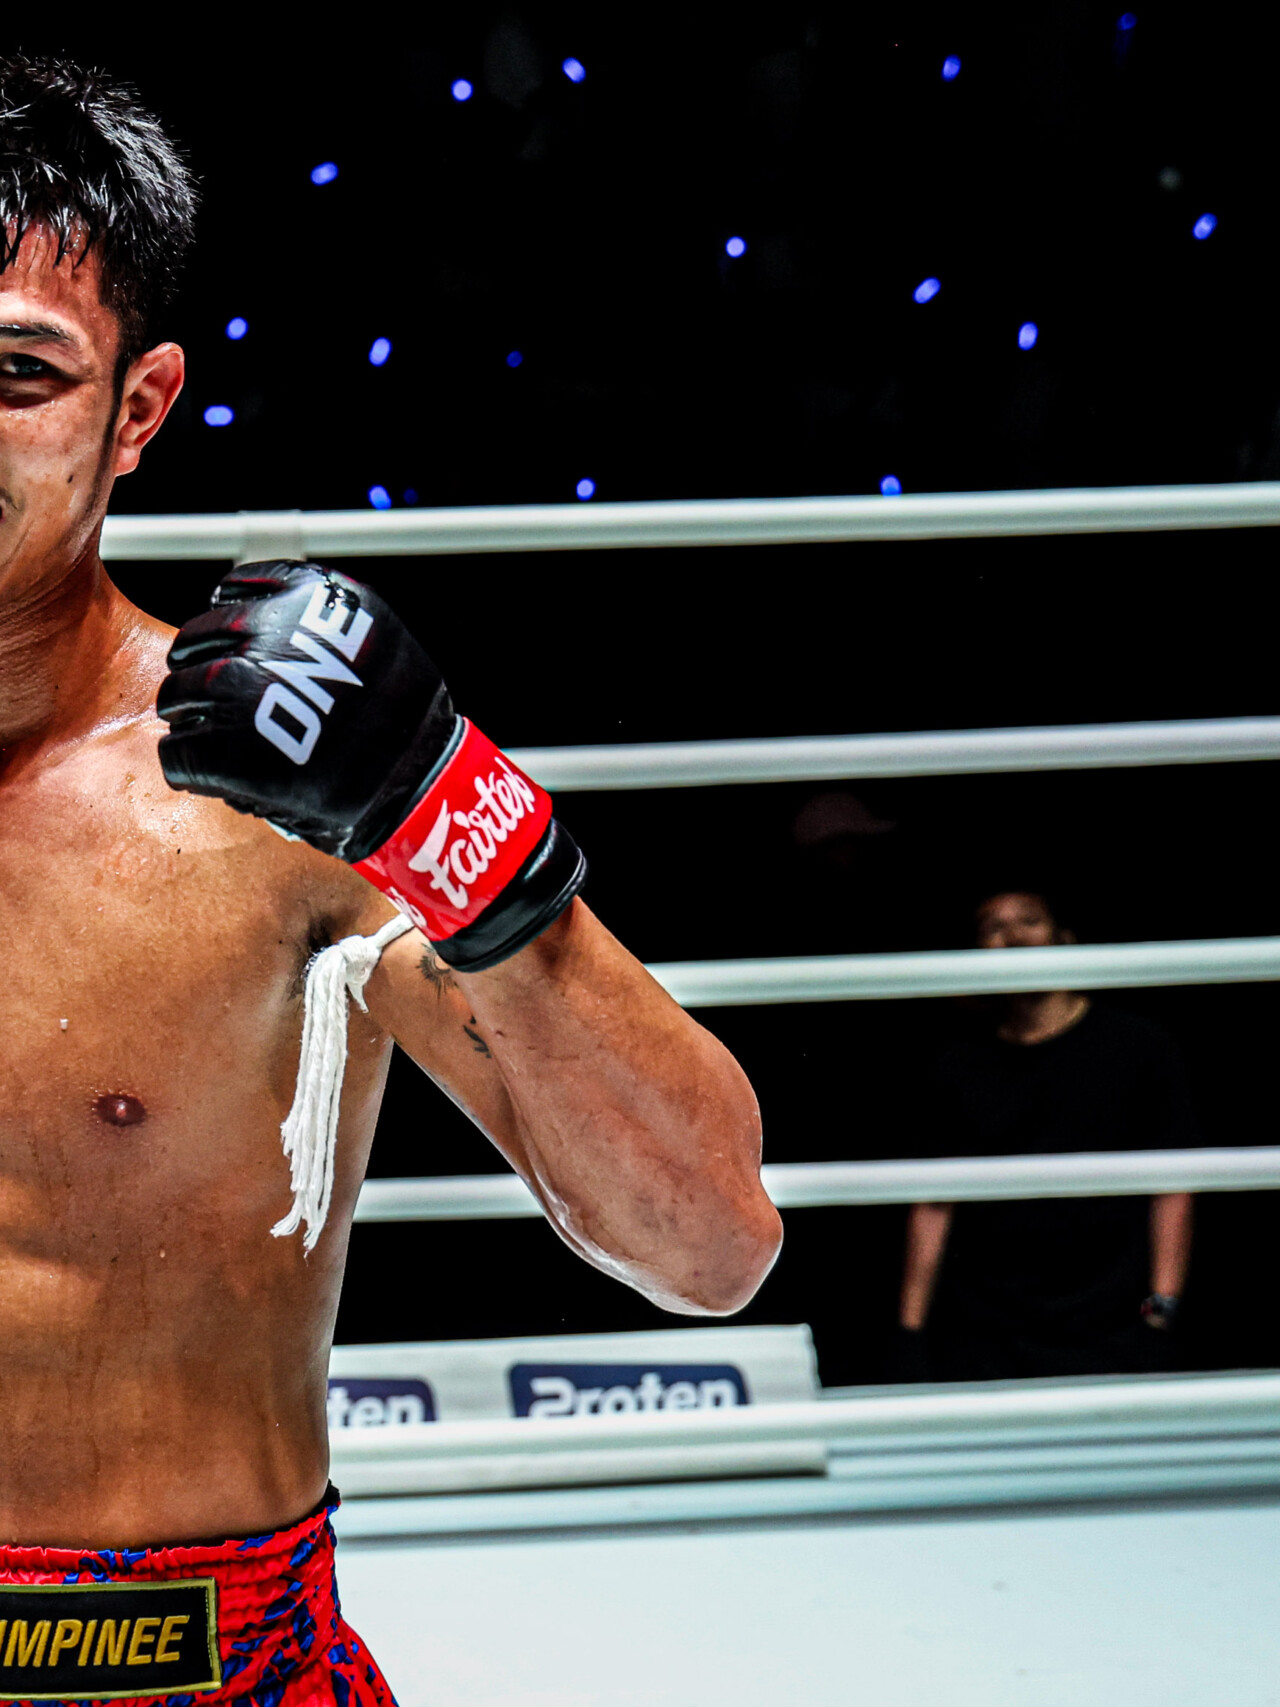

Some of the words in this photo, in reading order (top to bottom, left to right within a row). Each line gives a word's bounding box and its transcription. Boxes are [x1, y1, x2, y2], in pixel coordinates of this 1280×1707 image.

[254, 579, 374, 766] ONE
[407, 756, 536, 910] Fairtex
[327, 1384, 422, 1427] ten
